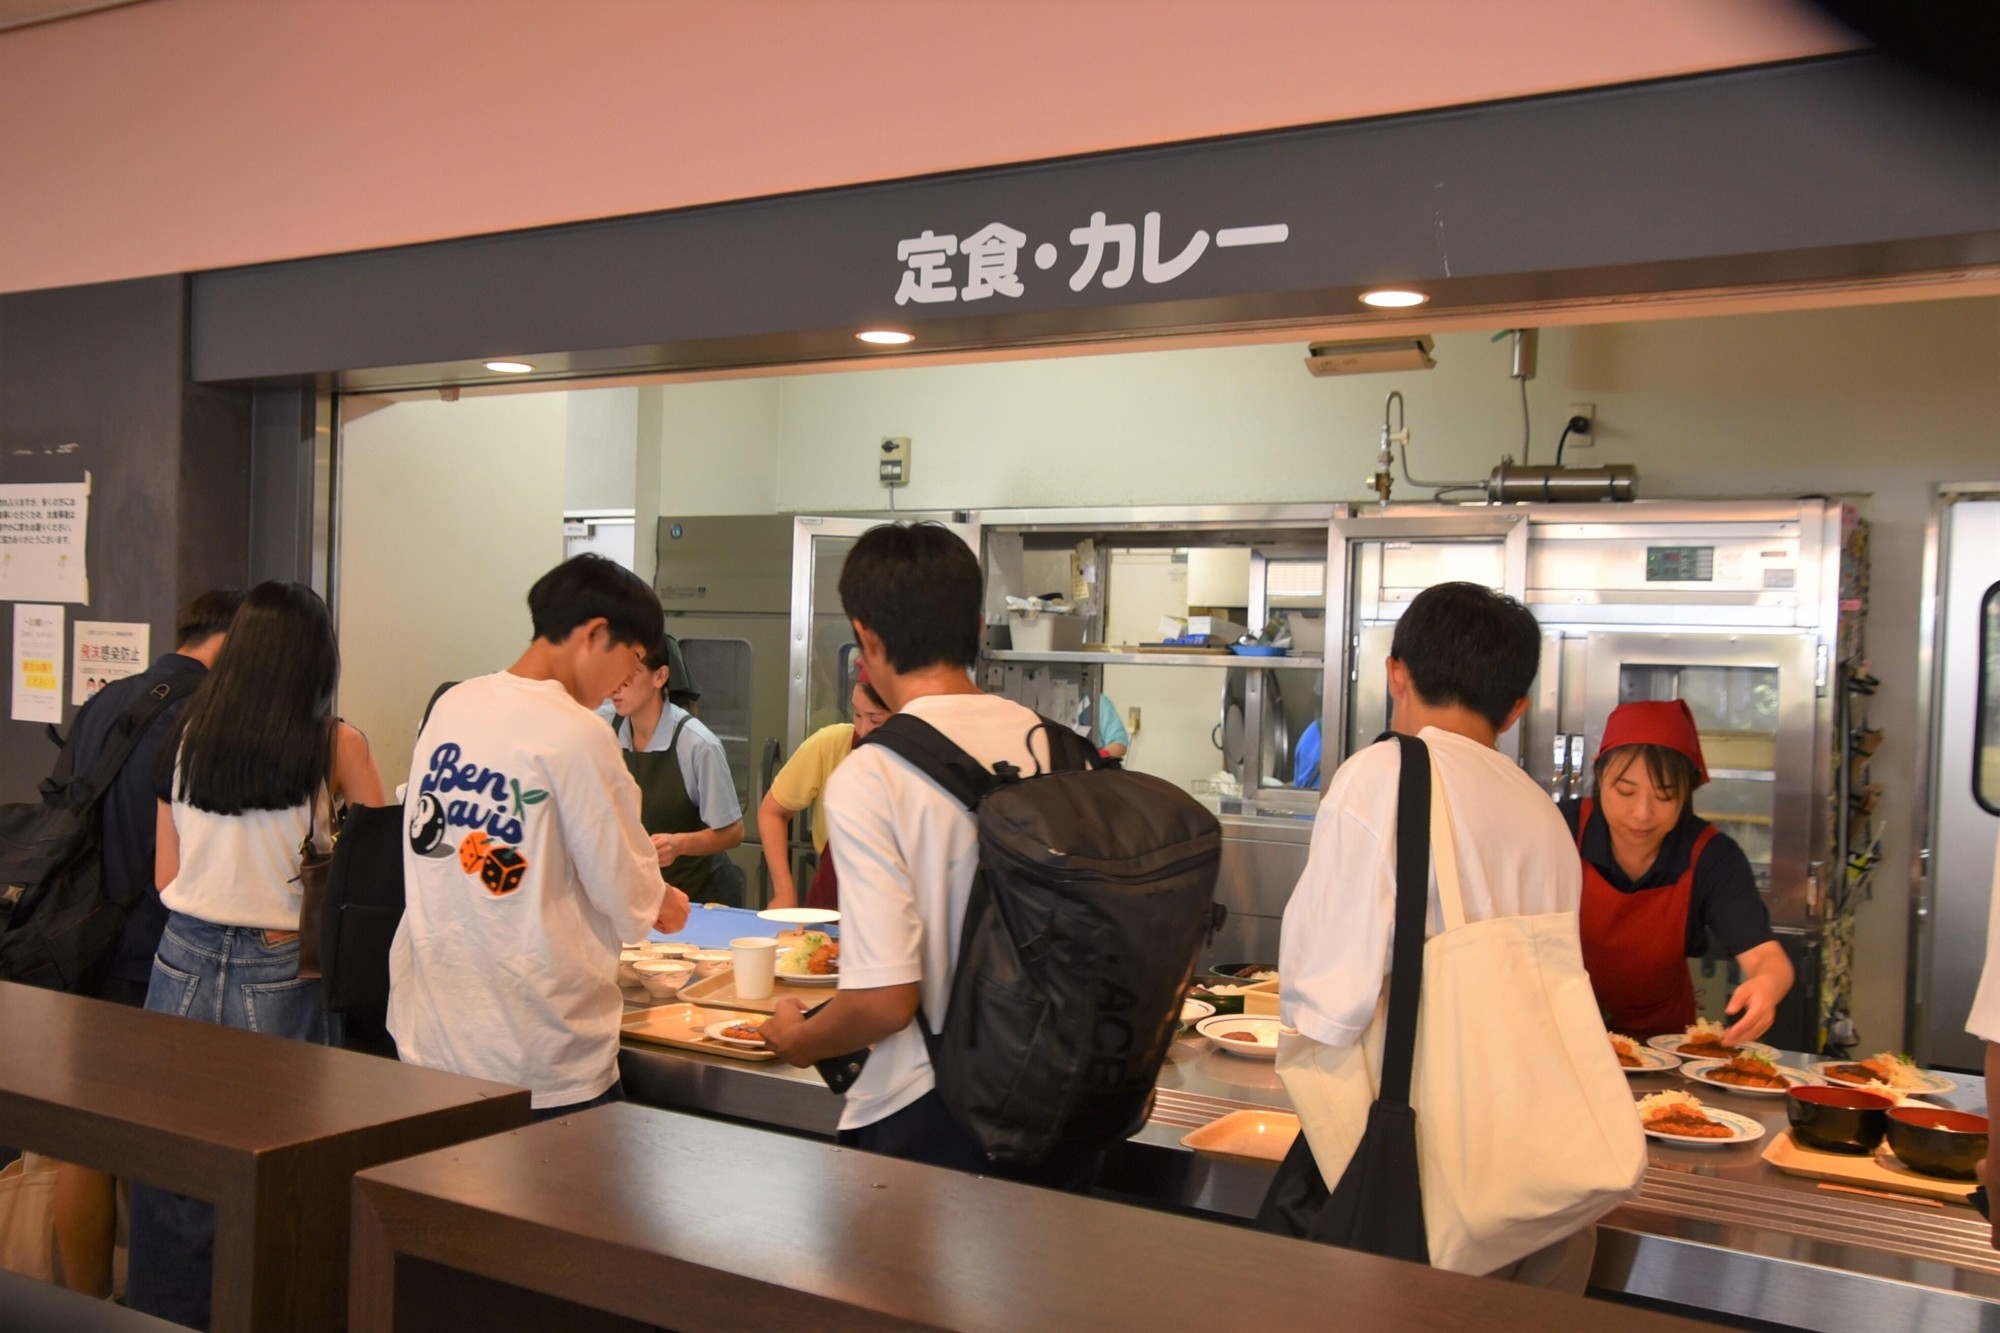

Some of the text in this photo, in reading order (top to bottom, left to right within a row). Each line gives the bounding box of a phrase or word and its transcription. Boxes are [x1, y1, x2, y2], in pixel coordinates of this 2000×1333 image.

[895, 210, 1290, 306] 定食・カレー
[81, 643, 140, 662] 飛沫感染防止
[420, 742, 509, 802] Ben
